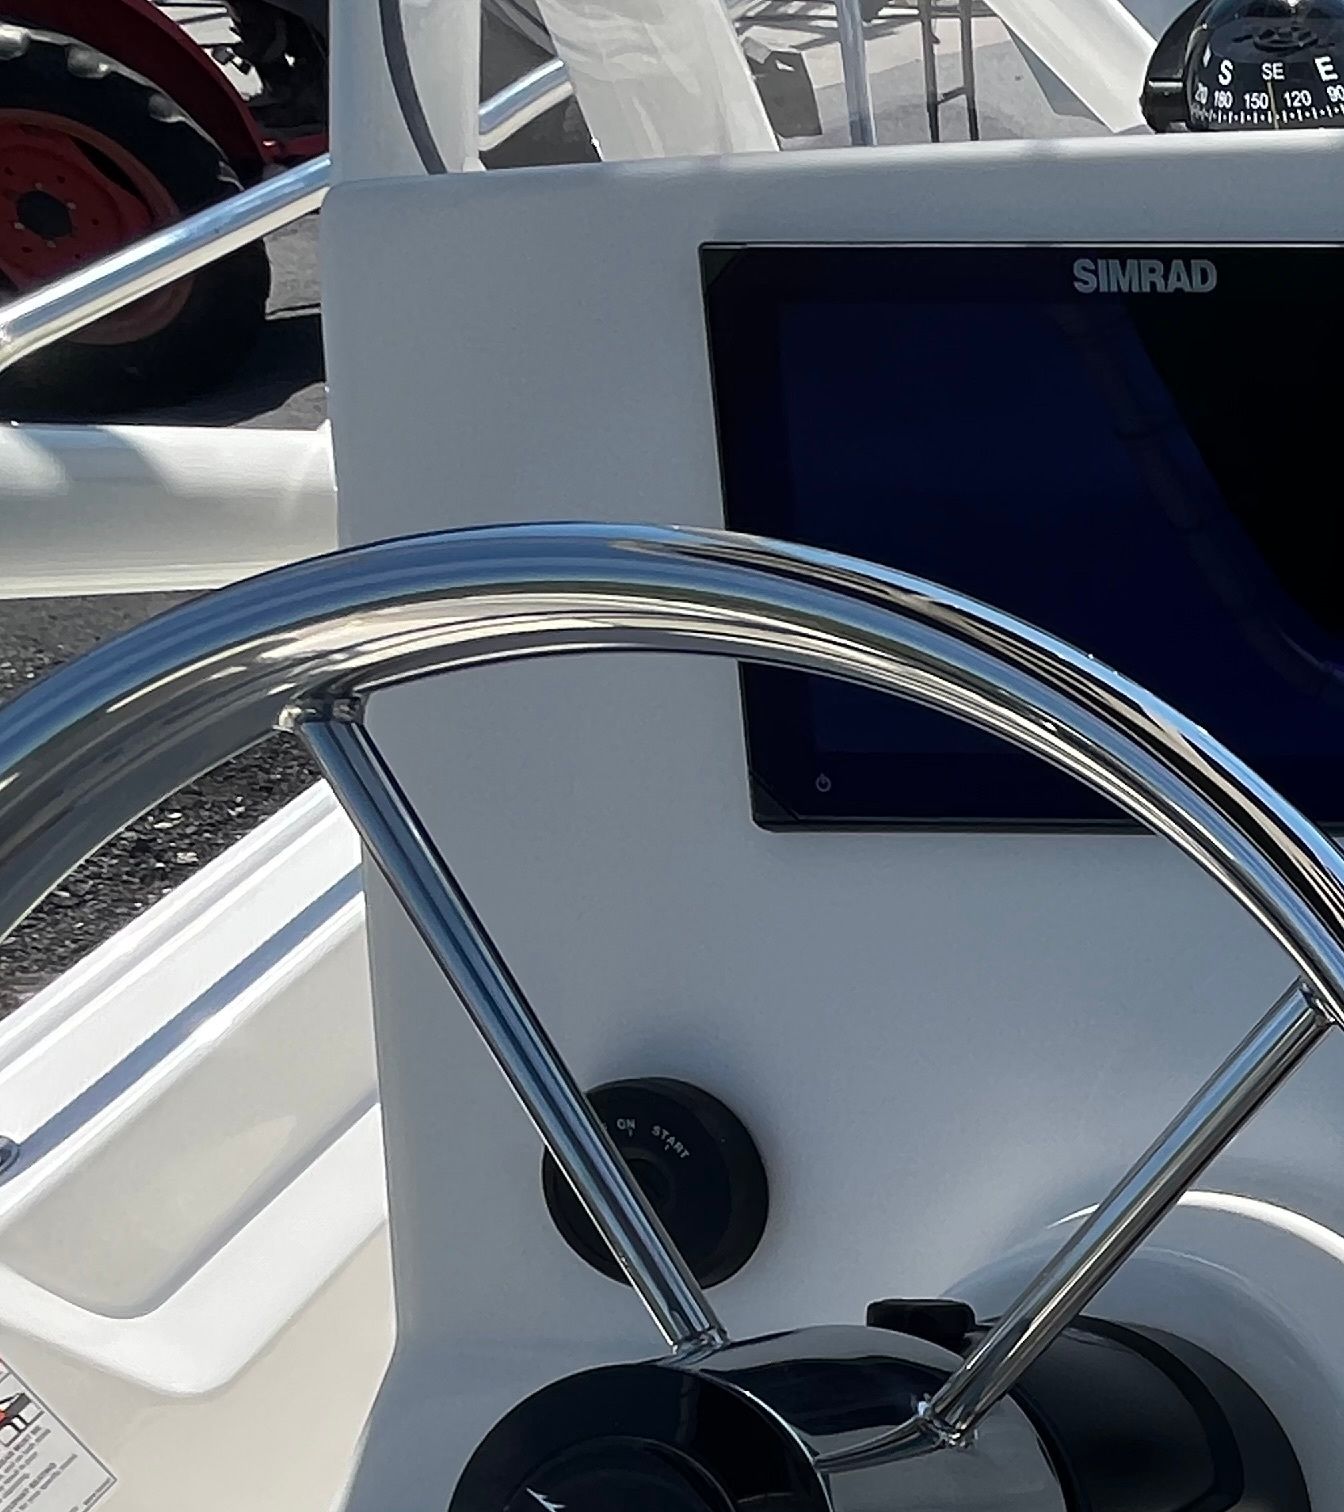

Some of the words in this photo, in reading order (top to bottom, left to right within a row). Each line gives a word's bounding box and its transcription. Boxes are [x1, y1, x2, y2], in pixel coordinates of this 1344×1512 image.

[1217, 59, 1233, 86] S
[1261, 62, 1285, 82] SE
[1314, 56, 1338, 82] E
[1244, 92, 1269, 110] 150
[1283, 89, 1312, 108] 120
[1073, 258, 1217, 293] SIMRAD
[651, 1125, 690, 1159] START
